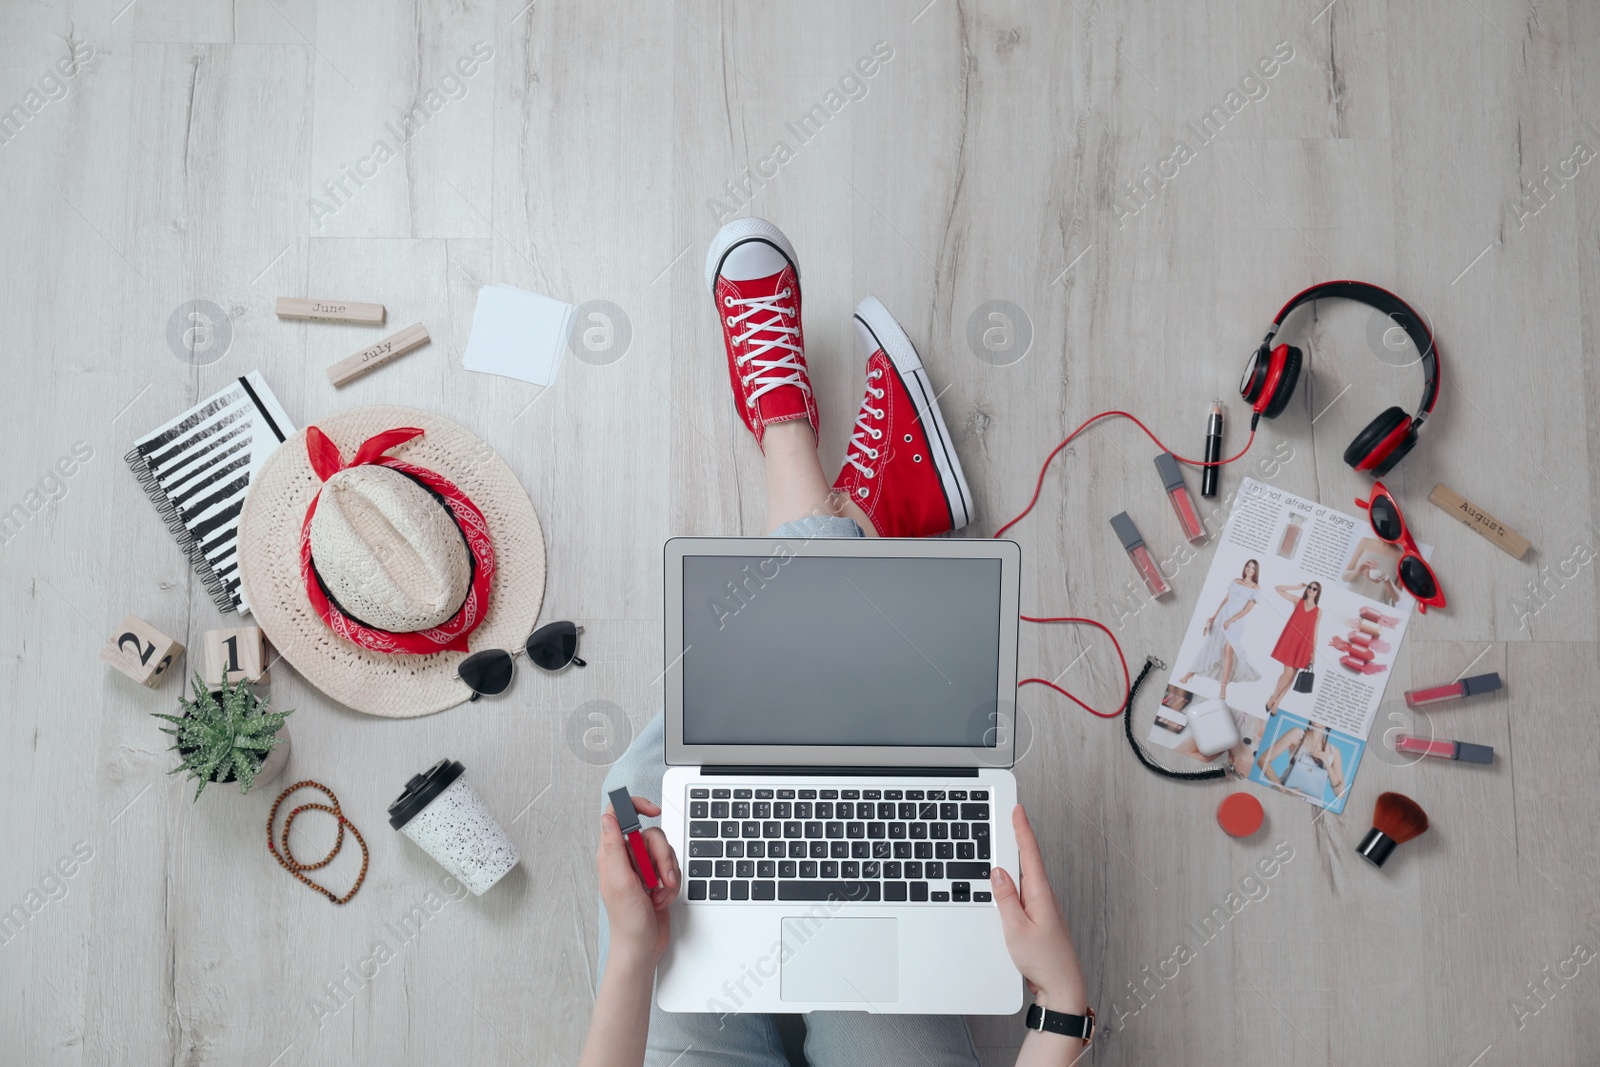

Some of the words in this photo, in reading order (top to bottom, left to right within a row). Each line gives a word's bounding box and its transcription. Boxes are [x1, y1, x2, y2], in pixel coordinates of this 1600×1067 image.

[312, 303, 346, 313] June
[362, 342, 392, 362] July
[1285, 497, 1313, 513] afraid
[1315, 509, 1327, 517] of
[1329, 515, 1355, 529] aging
[1460, 502, 1505, 536] August
[118, 632, 156, 667] 2
[222, 635, 244, 672] 1
